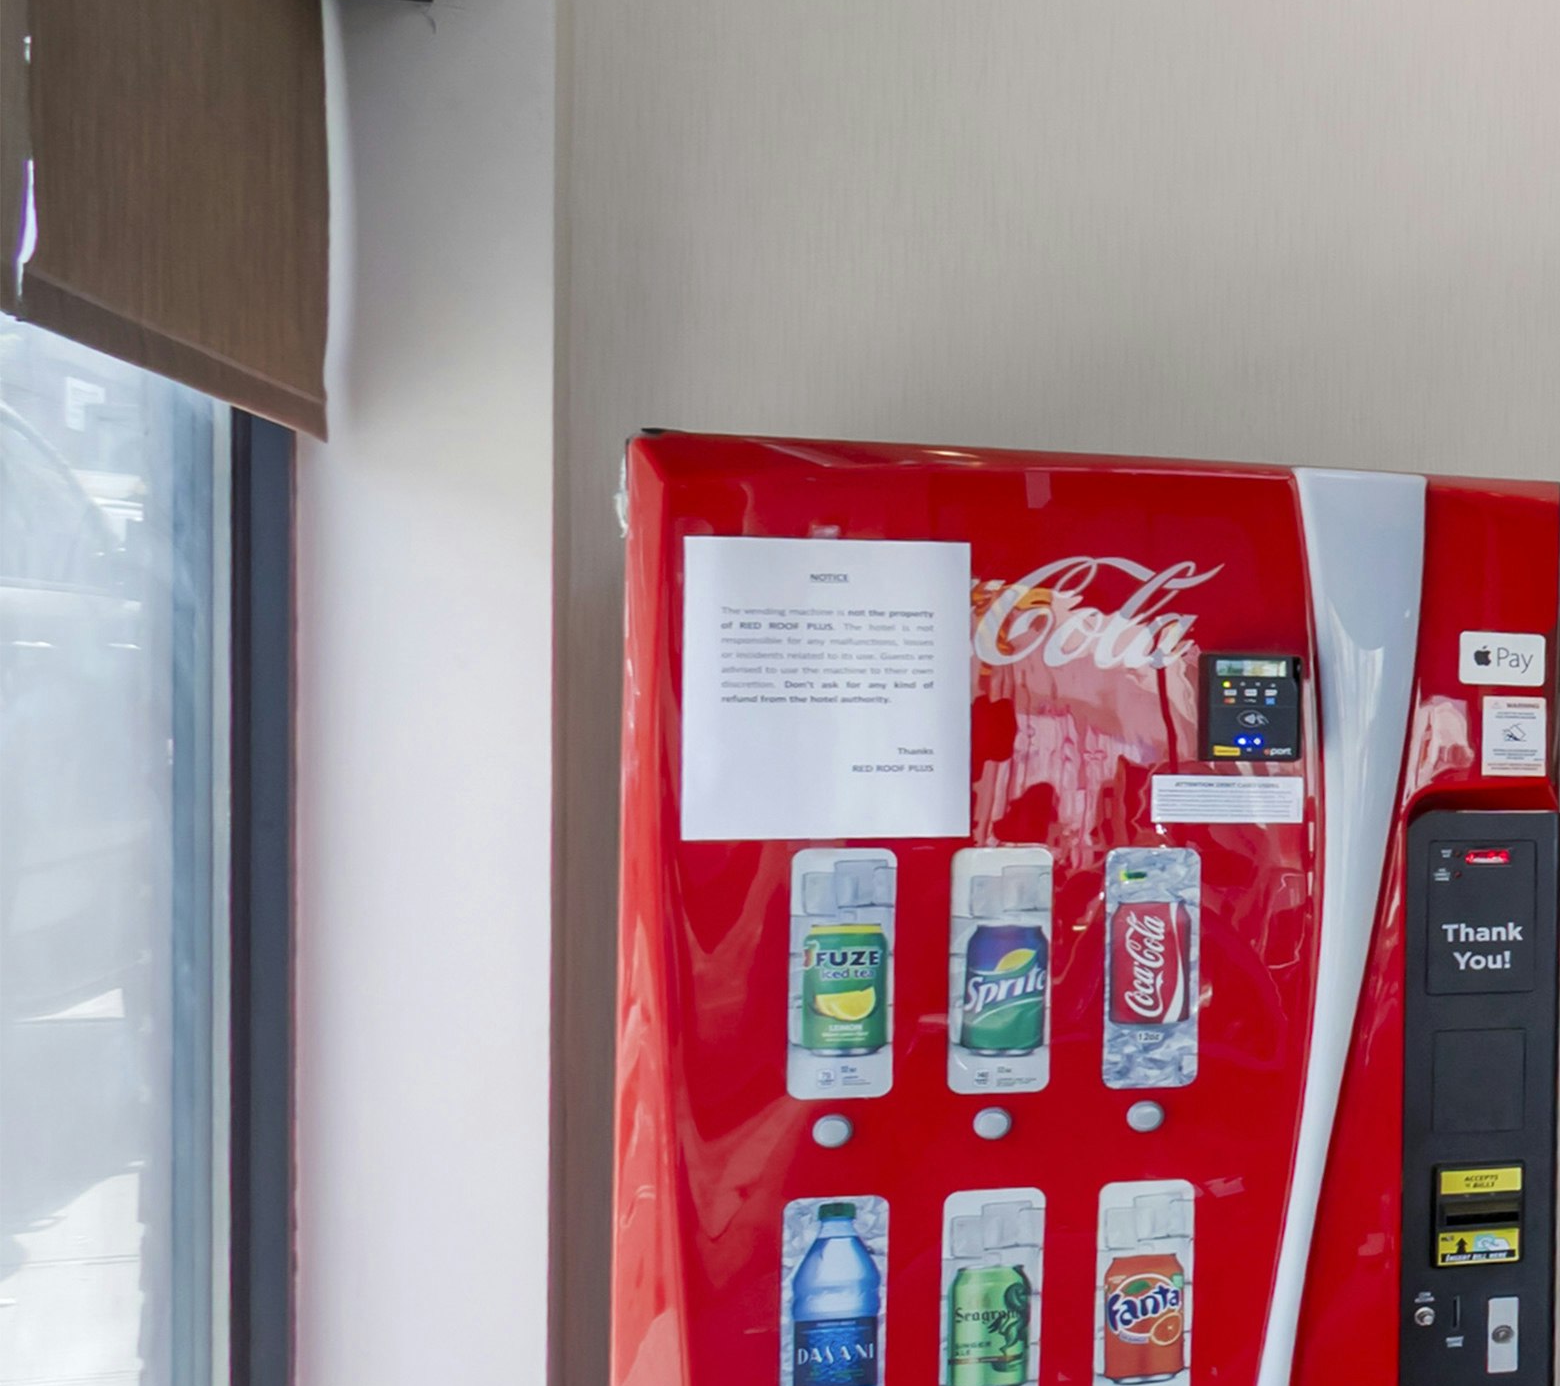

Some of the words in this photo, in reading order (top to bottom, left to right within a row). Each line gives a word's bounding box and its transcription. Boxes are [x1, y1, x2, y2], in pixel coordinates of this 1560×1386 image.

[810, 573, 849, 582] NOTICE
[721, 607, 741, 616] The
[744, 607, 785, 618] vending
[789, 608, 834, 616] machine
[848, 609, 865, 617] not
[869, 609, 885, 617] the
[889, 610, 934, 619] property
[974, 556, 1224, 668] Cola
[721, 621, 733, 629] of
[739, 622, 762, 630] RED
[769, 622, 799, 630] ROOF
[844, 623, 862, 631] The
[869, 623, 895, 631] hotel
[721, 636, 783, 646] responsible
[787, 636, 801, 645] for
[807, 638, 824, 647] any
[736, 651, 784, 660] incidents
[787, 651, 824, 660] related
[827, 652, 839, 660] to
[880, 652, 916, 661] Guests
[1497, 647, 1533, 674] Pay
[721, 666, 762, 674] advised
[802, 666, 819, 674] the
[823, 666, 867, 674] machine
[885, 667, 908, 675] their
[784, 680, 814, 689] Don't
[821, 680, 838, 689] ask
[846, 680, 860, 689] for
[868, 681, 886, 690] any
[894, 680, 916, 689] kind
[923, 680, 934, 689] of
[721, 694, 758, 703] refund
[760, 695, 787, 703] from
[789, 695, 807, 703] the
[810, 695, 838, 703] hotel
[898, 747, 934, 756] Thanks
[852, 764, 874, 773] RED
[876, 764, 906, 773] ROOF
[908, 764, 934, 773] PLUS
[1442, 922, 1523, 942] Thank
[816, 950, 880, 966] FUZE
[1453, 951, 1511, 970] You!
[822, 968, 849, 979] iced
[855, 968, 876, 979] tea
[964, 965, 1046, 1013] Sprite
[1464, 1174, 1499, 1182] ACCEPTS
[797, 1343, 874, 1365] DASANI
